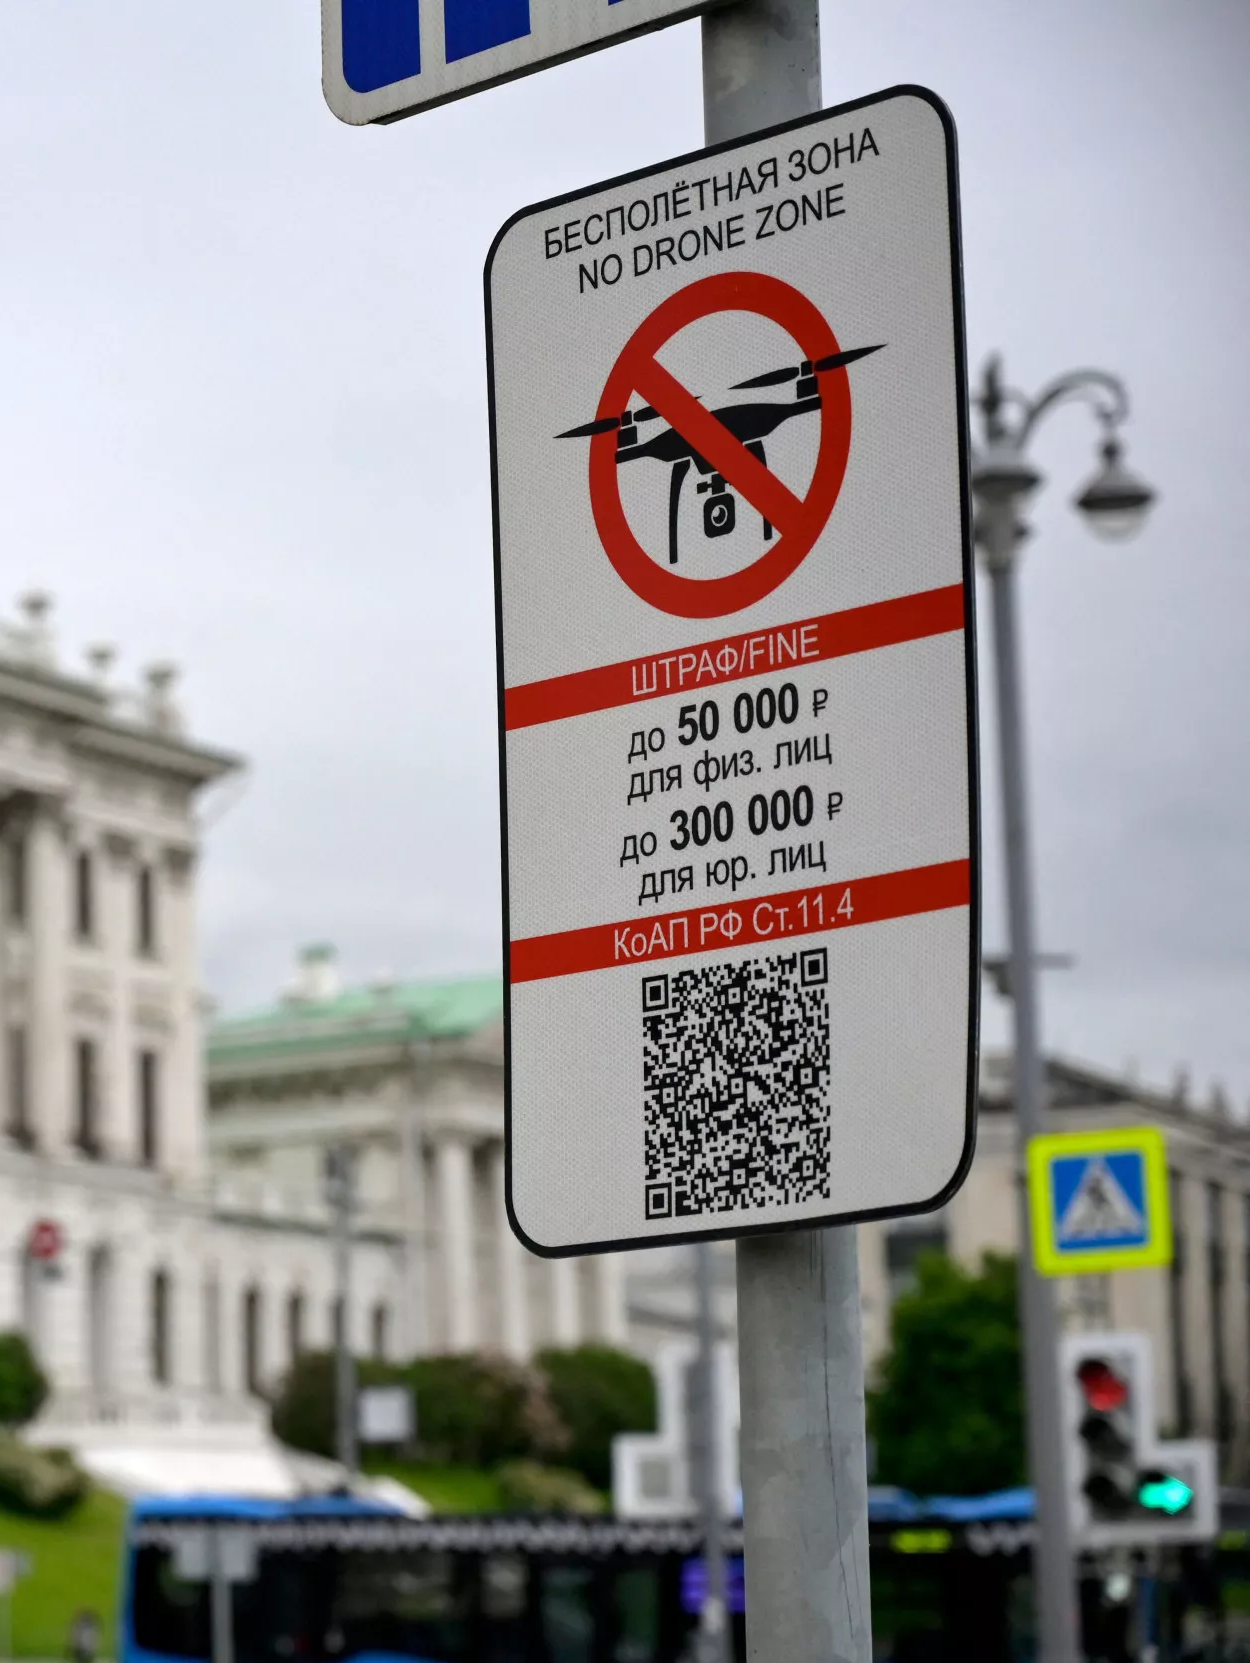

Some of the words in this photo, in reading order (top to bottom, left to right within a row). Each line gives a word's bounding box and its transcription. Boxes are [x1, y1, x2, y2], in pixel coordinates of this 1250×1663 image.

[544, 156, 779, 260] БЕСПОЛЁТНАЯ
[787, 127, 880, 182] ЗОНА
[578, 253, 623, 294] NO
[633, 213, 746, 278] DRONE
[755, 182, 846, 241] ZONE
[631, 623, 820, 697] ШТРАФ/FINE
[627, 727, 666, 765] до
[677, 699, 720, 746] 50
[733, 682, 800, 734] 000
[627, 764, 683, 806] для
[693, 749, 762, 793] физ.
[773, 732, 833, 770] лиц
[619, 831, 658, 868] до
[669, 800, 734, 851] 300
[747, 784, 814, 836] 000
[638, 865, 694, 907] для
[706, 855, 757, 892] юр.
[767, 840, 827, 876] лиц
[613, 916, 689, 960] КоАП
[700, 908, 743, 946] РФ
